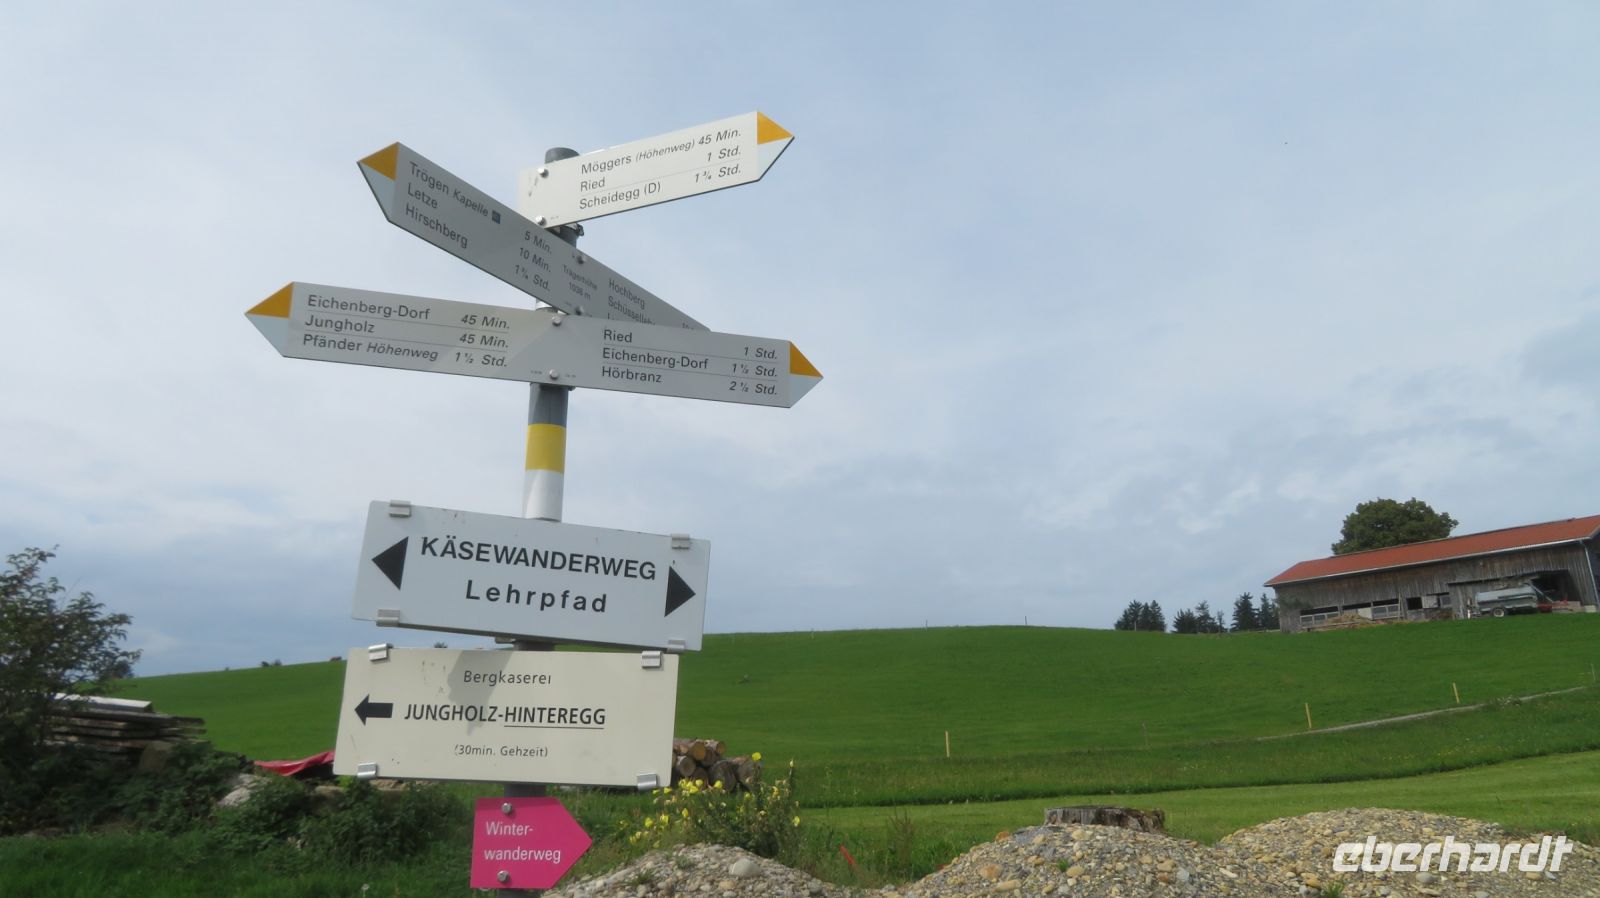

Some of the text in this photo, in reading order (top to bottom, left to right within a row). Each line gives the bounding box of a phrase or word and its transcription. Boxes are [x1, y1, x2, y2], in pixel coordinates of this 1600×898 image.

[581, 129, 741, 174] Möggers (Höhenweg) 45 Min.
[580, 147, 741, 192] Ried 1 Std.
[579, 187, 640, 210] Scheidegg
[644, 182, 661, 196] (D)
[718, 165, 741, 178] Std.
[410, 161, 552, 254] Trögen Kapelle 5 Min.
[408, 183, 551, 272] Letze 10 Min.
[406, 204, 467, 248] Hirschberg
[533, 274, 550, 291] Std.
[609, 278, 645, 309] Hochberg
[308, 295, 510, 329] Eichenberg-Dorf 45 Min.
[305, 315, 509, 348] Jungholz 45 Min.
[604, 329, 777, 359] Ried 1 Std.
[303, 334, 362, 352] Pfänder
[366, 342, 438, 362] Höhenweg
[481, 354, 507, 367] Std.
[603, 348, 709, 370] Eichenberg-Dorf
[755, 366, 777, 377] Std.
[602, 367, 662, 383] Hörbranz
[755, 384, 777, 395] Std.
[421, 535, 656, 580] KÄSEWANDERWEG
[466, 580, 607, 613] Lehrpfad
[405, 703, 606, 726] JUNGHOLZ-HINTEREGG
[501, 746, 548, 757] Gehzeit)
[485, 822, 533, 836] Winter-
[484, 847, 561, 863] wanderweg
